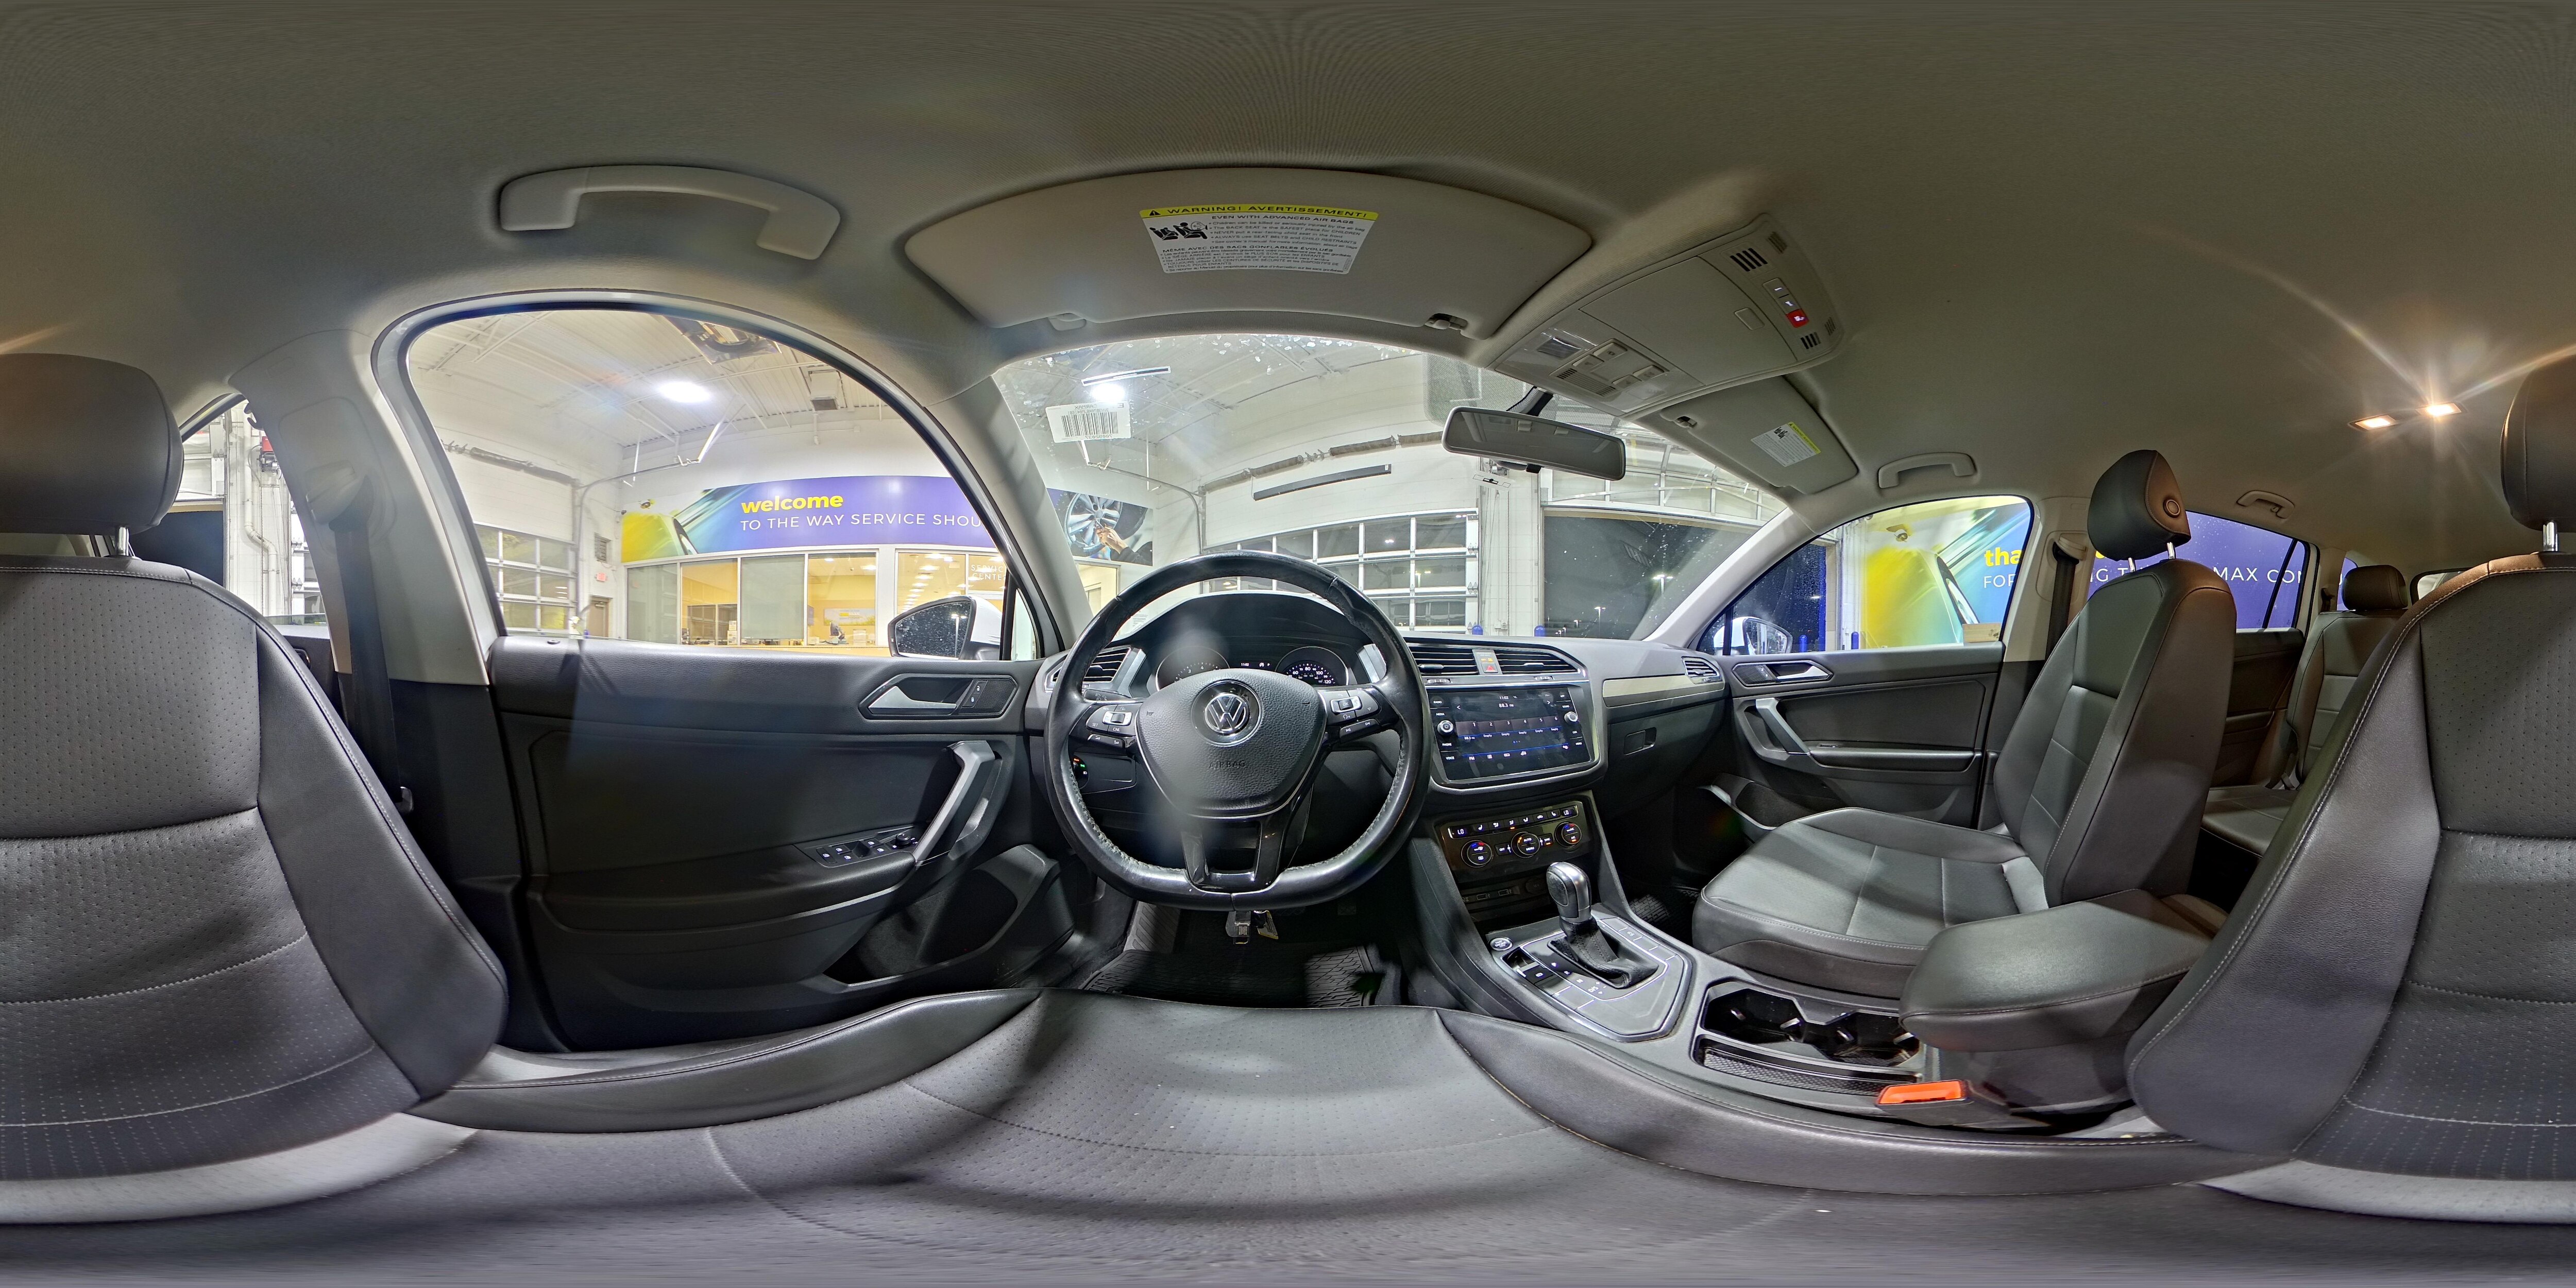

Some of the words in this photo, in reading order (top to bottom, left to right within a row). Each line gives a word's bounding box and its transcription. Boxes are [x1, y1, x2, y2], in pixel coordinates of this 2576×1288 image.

[1248, 206, 1367, 217] AVERTISSEMENT!
[741, 493, 843, 514] welcome
[741, 517, 760, 531] TO
[767, 516, 800, 529] THE
[806, 514, 845, 527] WAY
[851, 513, 925, 526] SERVICE
[932, 514, 981, 528] SHOU
[1984, 547, 2022, 567] tha
[1209, 760, 1246, 769] AIRBAG
